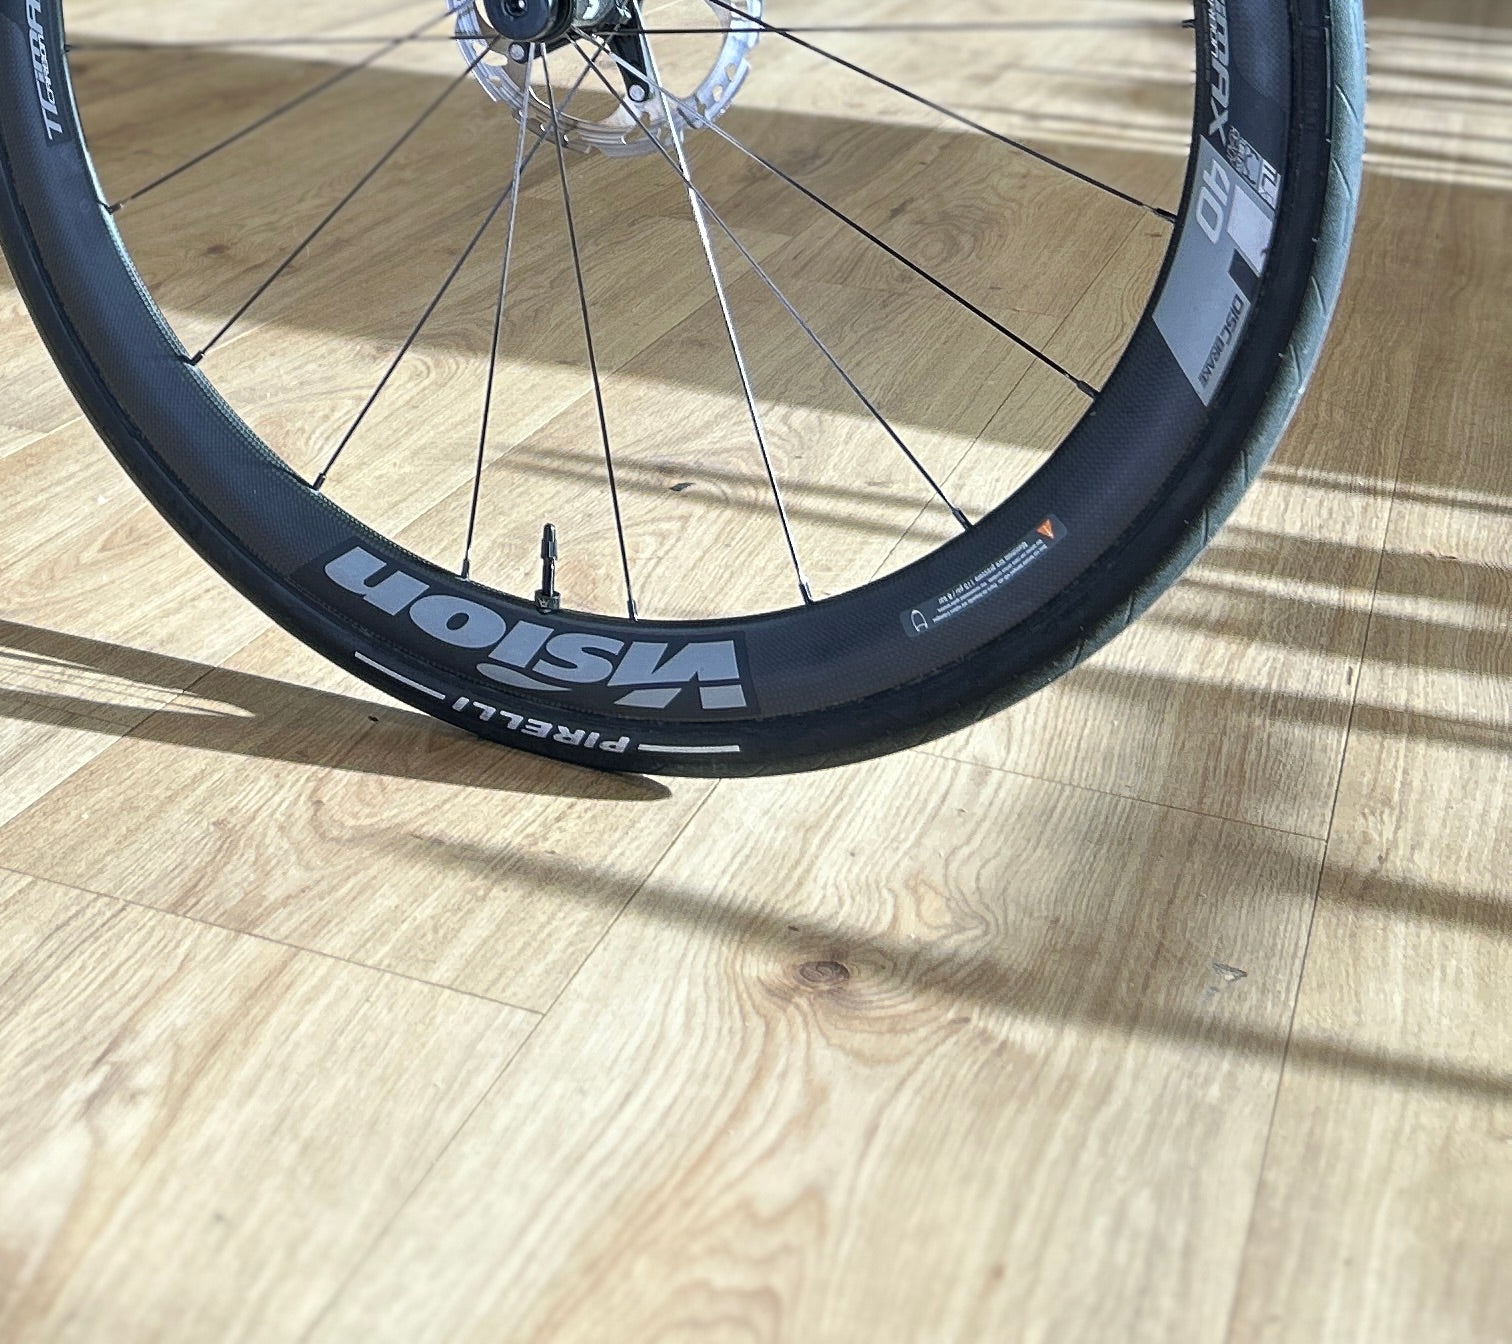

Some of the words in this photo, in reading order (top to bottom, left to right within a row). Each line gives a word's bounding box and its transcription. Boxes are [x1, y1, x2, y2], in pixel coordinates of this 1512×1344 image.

[1195, 158, 1231, 246] 40
[324, 546, 748, 709] Vision
[451, 696, 631, 754] PIRELLI
